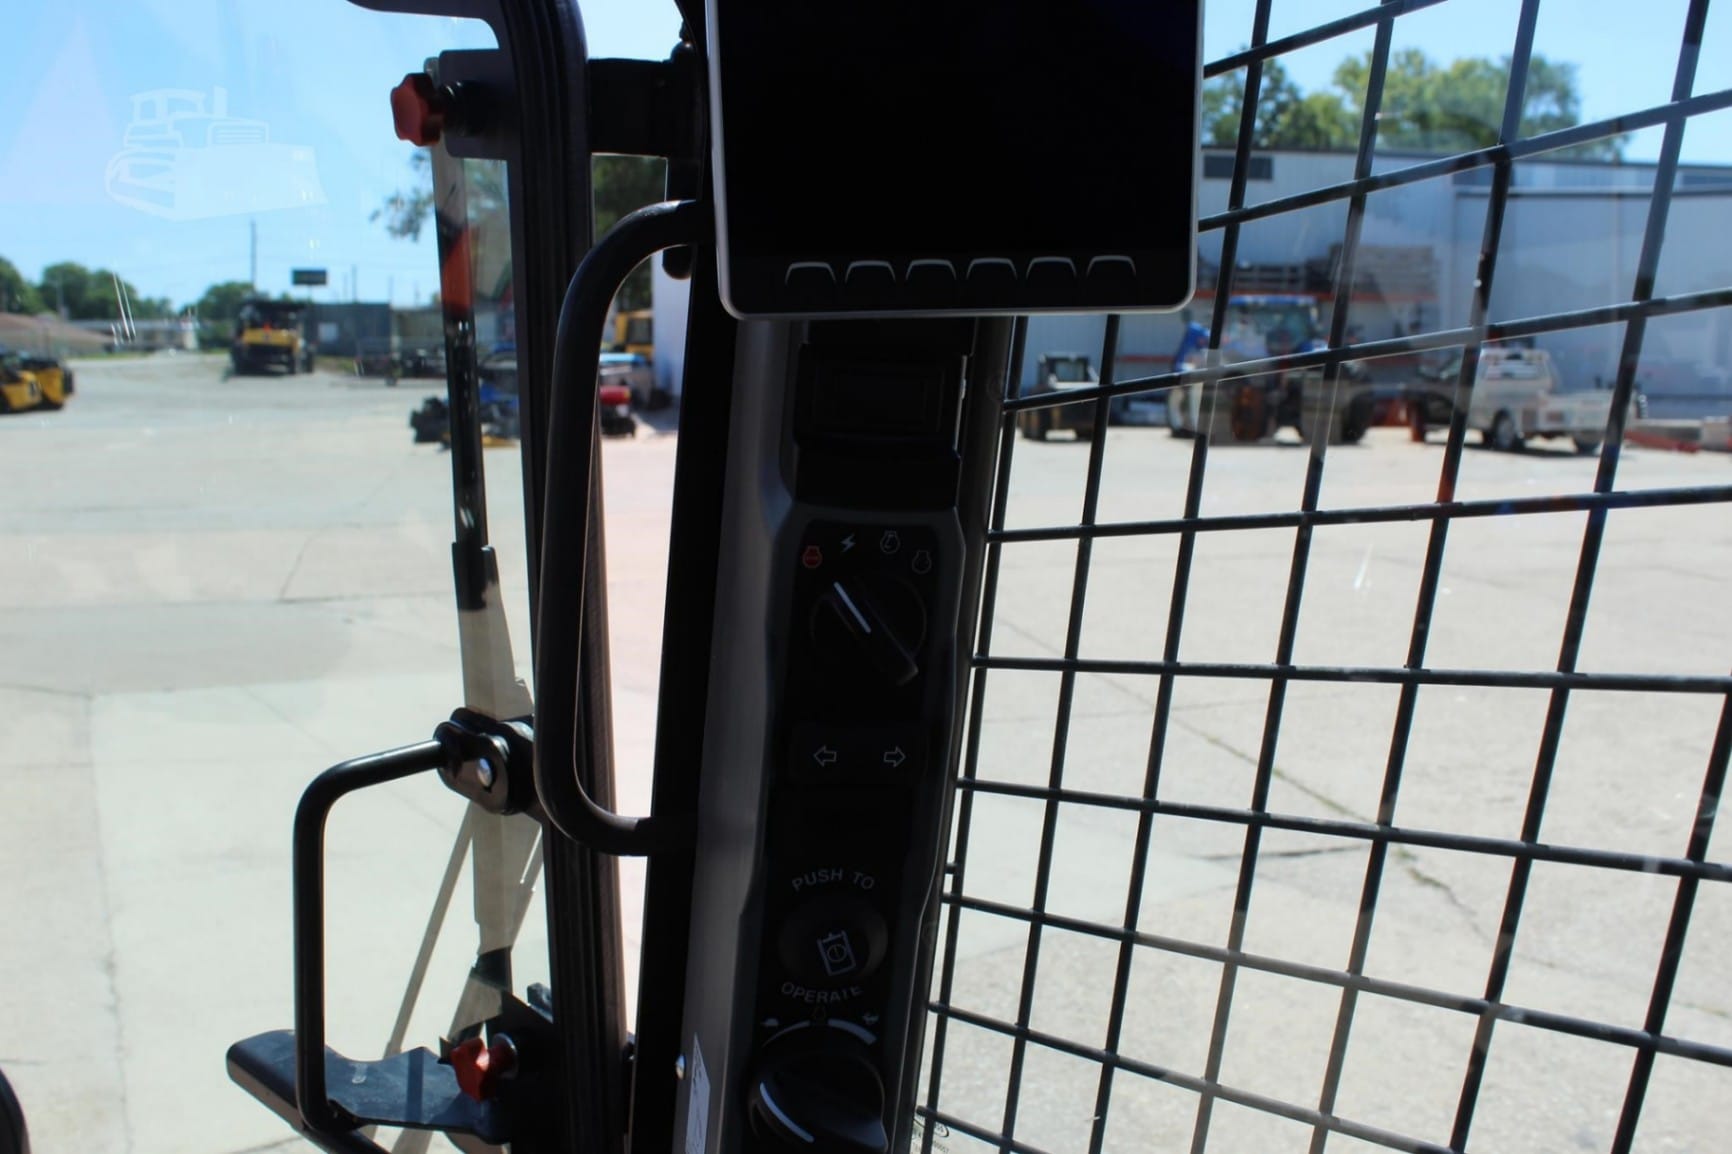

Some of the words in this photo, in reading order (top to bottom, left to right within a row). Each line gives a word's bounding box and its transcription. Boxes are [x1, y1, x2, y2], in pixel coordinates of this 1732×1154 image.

[792, 868, 844, 891] PUSH
[853, 871, 876, 890] TO
[782, 981, 862, 1003] OPERATE
